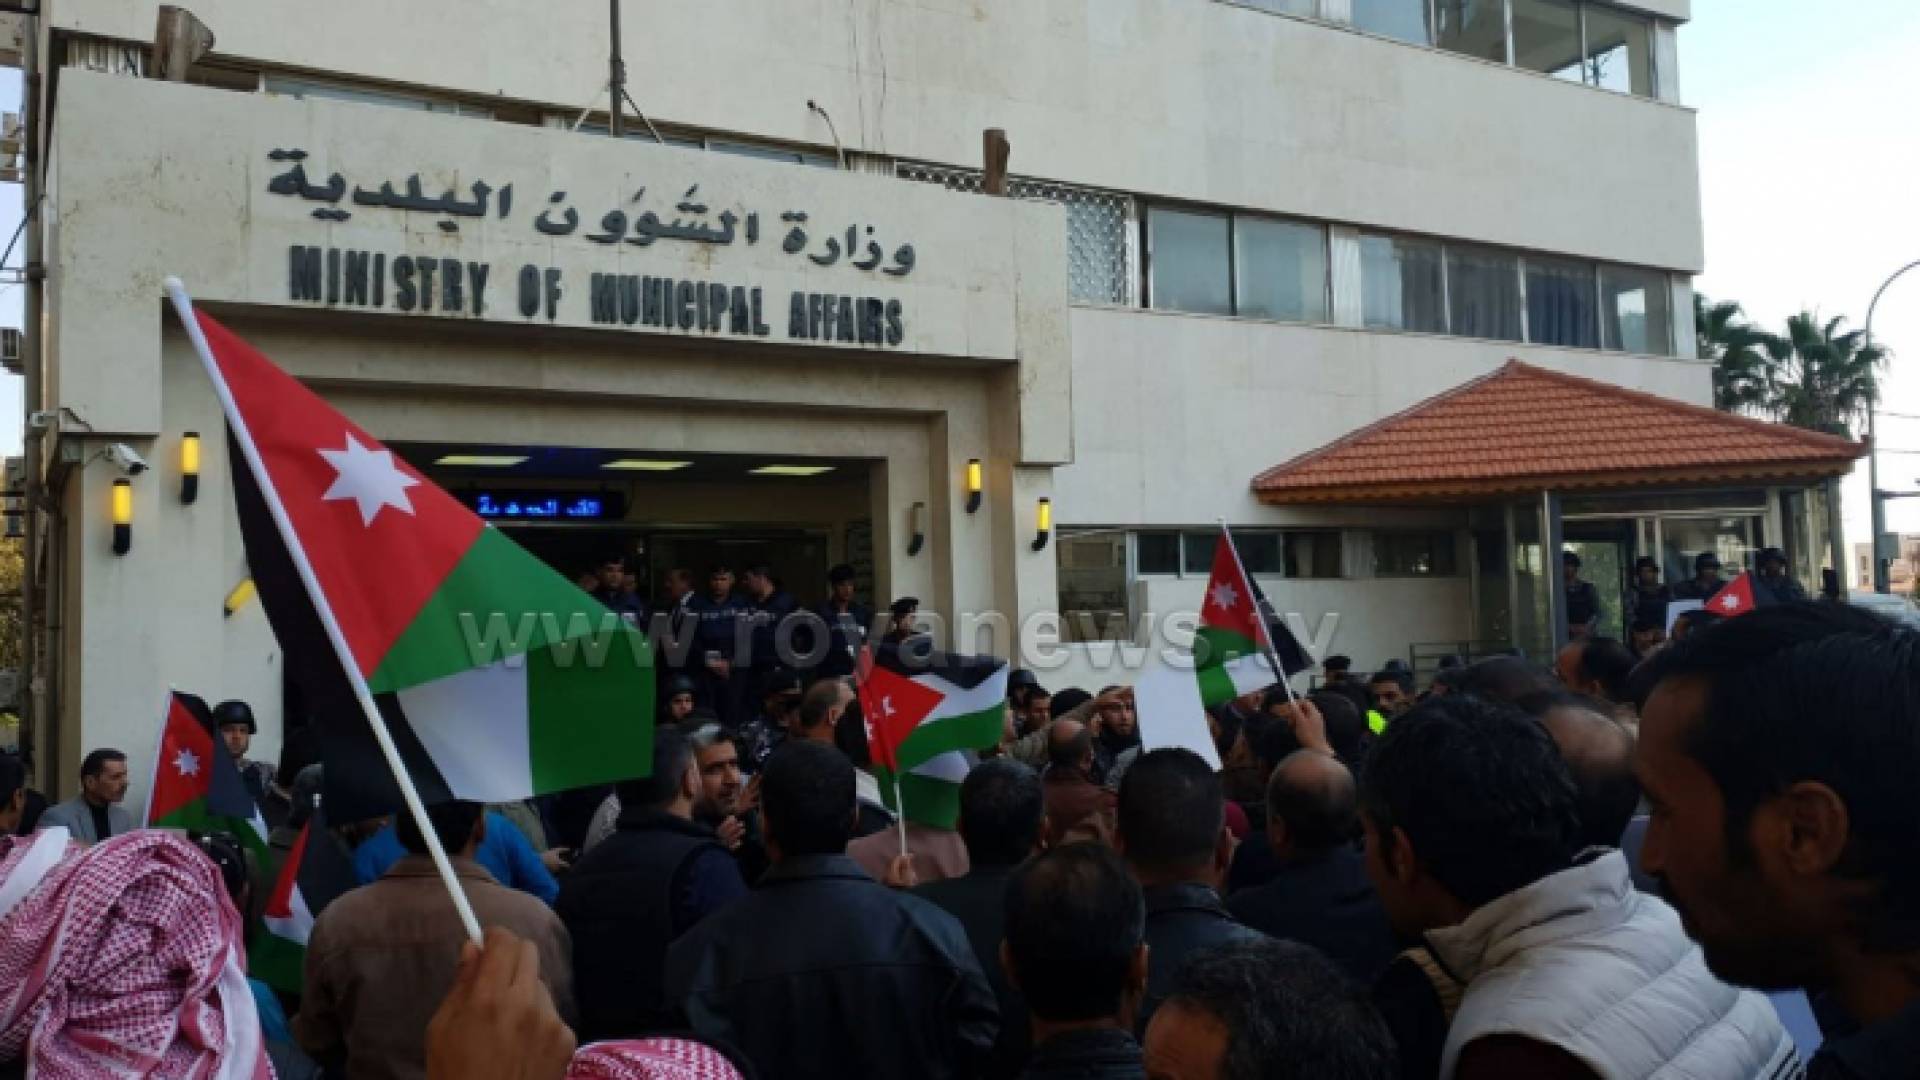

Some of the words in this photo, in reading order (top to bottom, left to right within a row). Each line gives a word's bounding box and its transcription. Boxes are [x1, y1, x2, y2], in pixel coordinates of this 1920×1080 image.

[267, 147, 512, 233] البلدية
[780, 210, 916, 276] وزارة
[289, 245, 490, 317] MINISTRY
[518, 263, 562, 321] OF
[591, 272, 770, 336] MUNICIPAL
[788, 291, 904, 346] AFFAIRS
